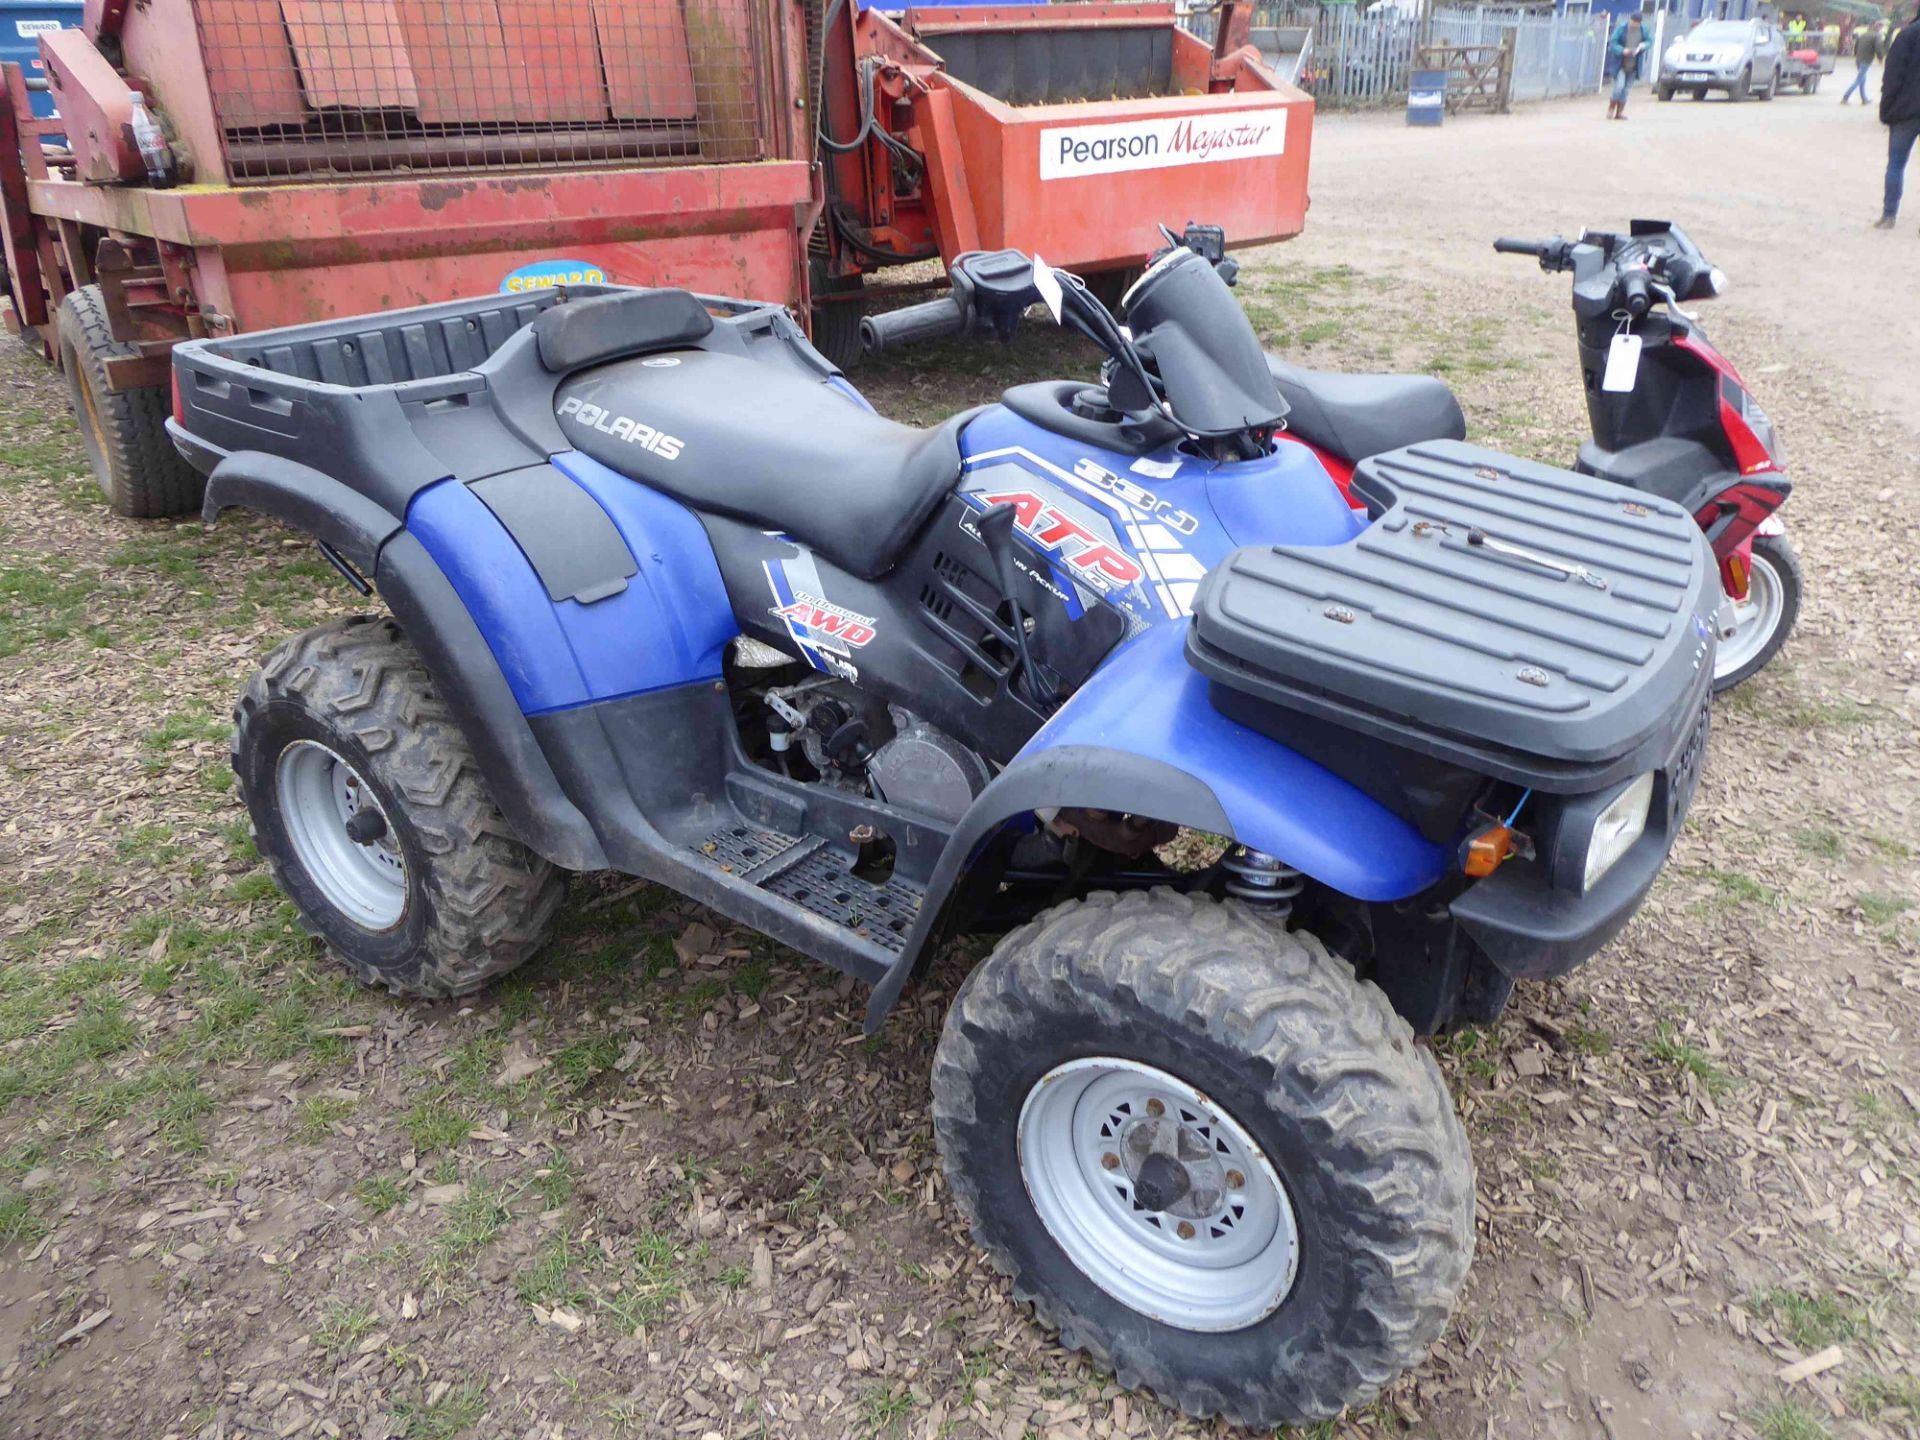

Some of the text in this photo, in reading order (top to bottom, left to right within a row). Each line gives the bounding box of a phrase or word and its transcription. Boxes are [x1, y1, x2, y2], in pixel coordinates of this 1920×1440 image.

[21, 23, 58, 31] SEWARD
[1060, 119, 1272, 165] Pearson Megastar
[557, 396, 686, 461] POLARIS
[976, 490, 1145, 588] ATP
[772, 602, 876, 646] AWD
